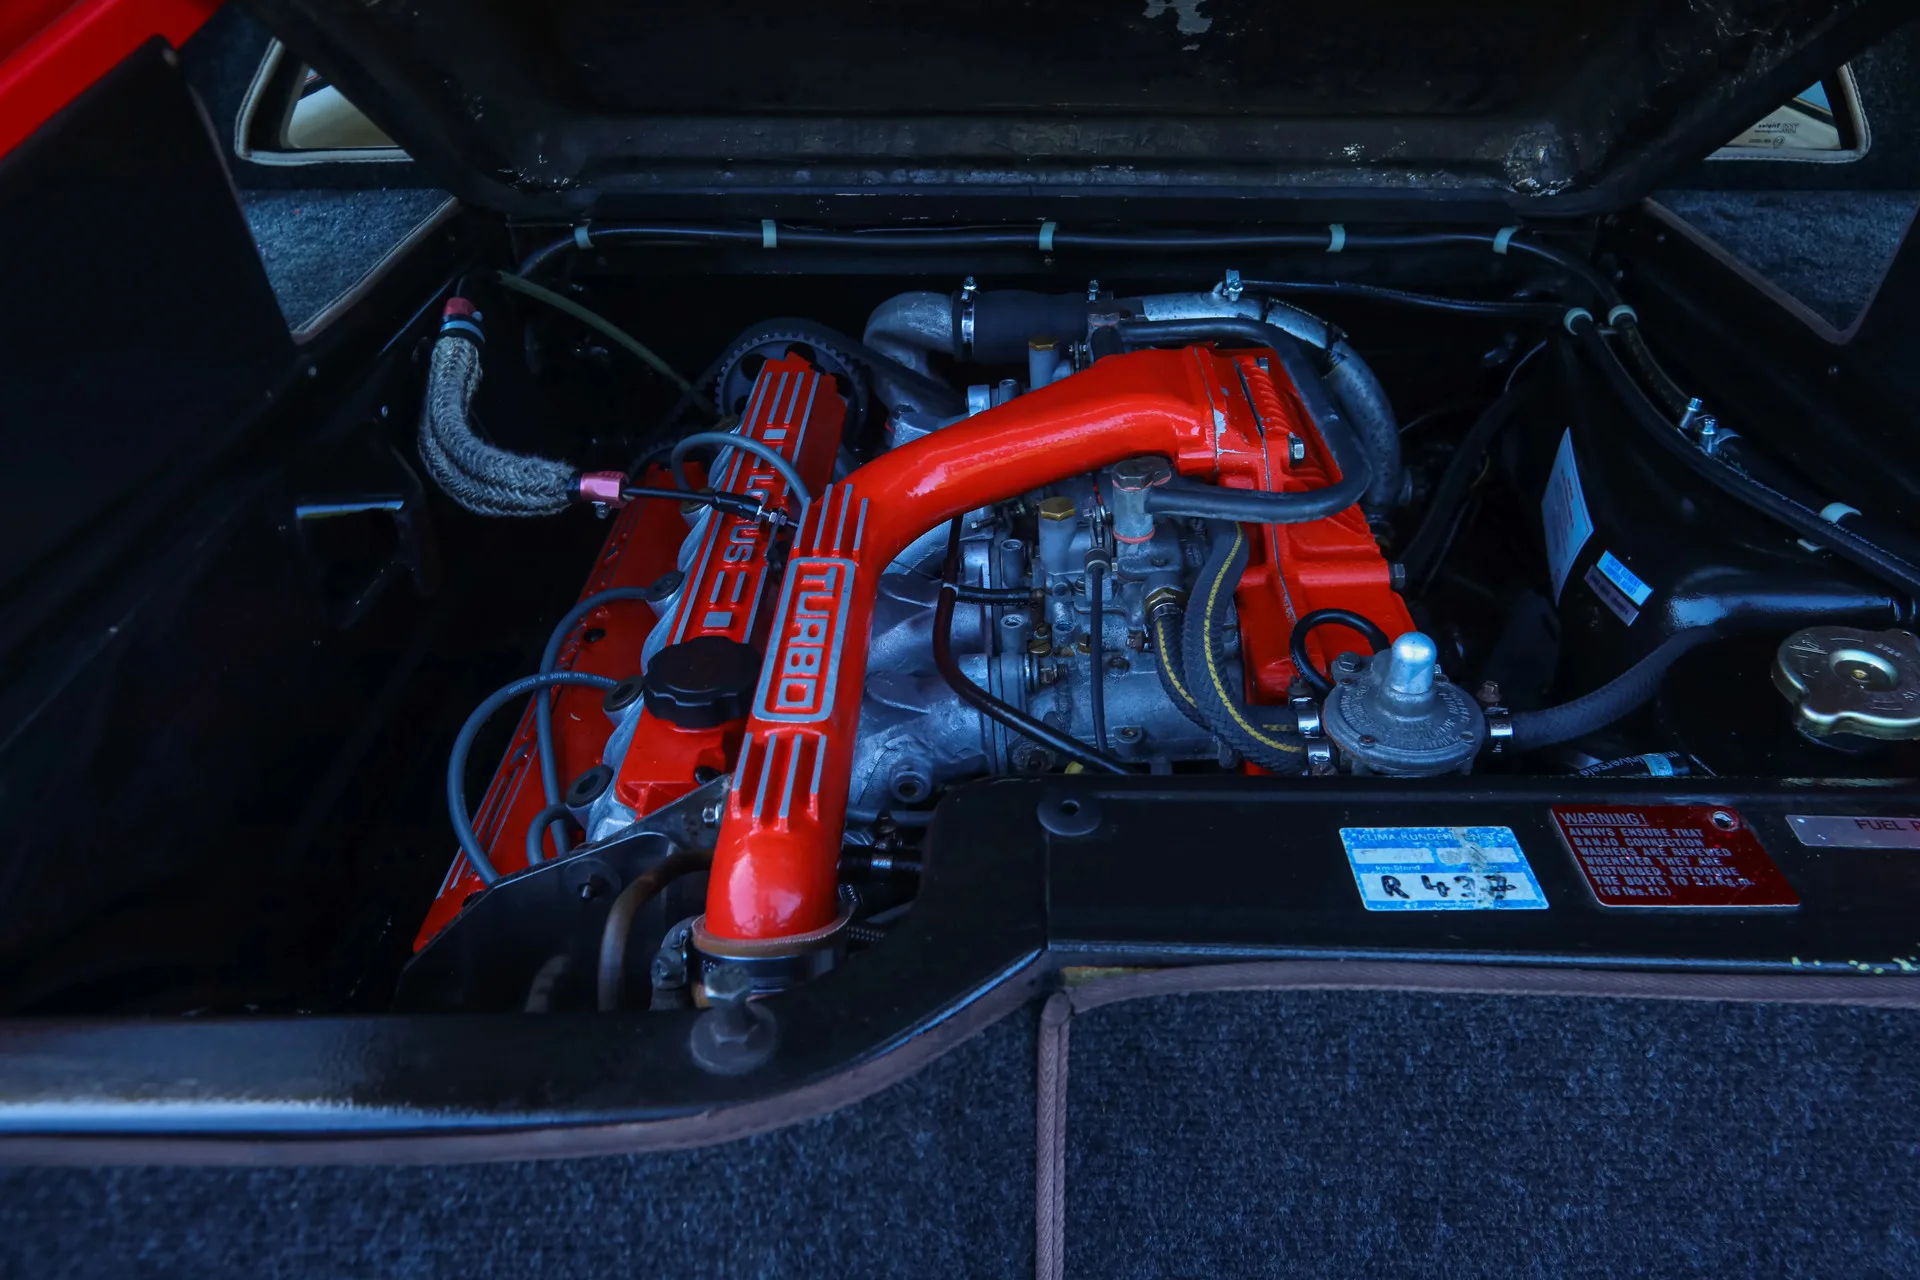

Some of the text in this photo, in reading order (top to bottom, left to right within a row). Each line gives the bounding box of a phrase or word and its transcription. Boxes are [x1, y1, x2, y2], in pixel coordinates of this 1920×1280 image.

[723, 474, 777, 562] LOUS
[777, 566, 838, 708] TURBO
[1559, 812, 1648, 825] WARNING!
[1854, 819, 1907, 831] FUEL
[1569, 828, 1704, 838] ALWAYS ENSURE THAT
[1573, 838, 1704, 847] BANJO CONNECTION
[1577, 847, 1732, 857] WASHERS ARE RENEWED
[1582, 856, 1723, 866] WHENEVER THEY ARE
[1670, 866, 1740, 876] RETORQUE
[1593, 876, 1621, 886] THE
[1624, 876, 1667, 886] BOLTS
[1669, 876, 1689, 886] TO
[1381, 875, 1410, 899] R
